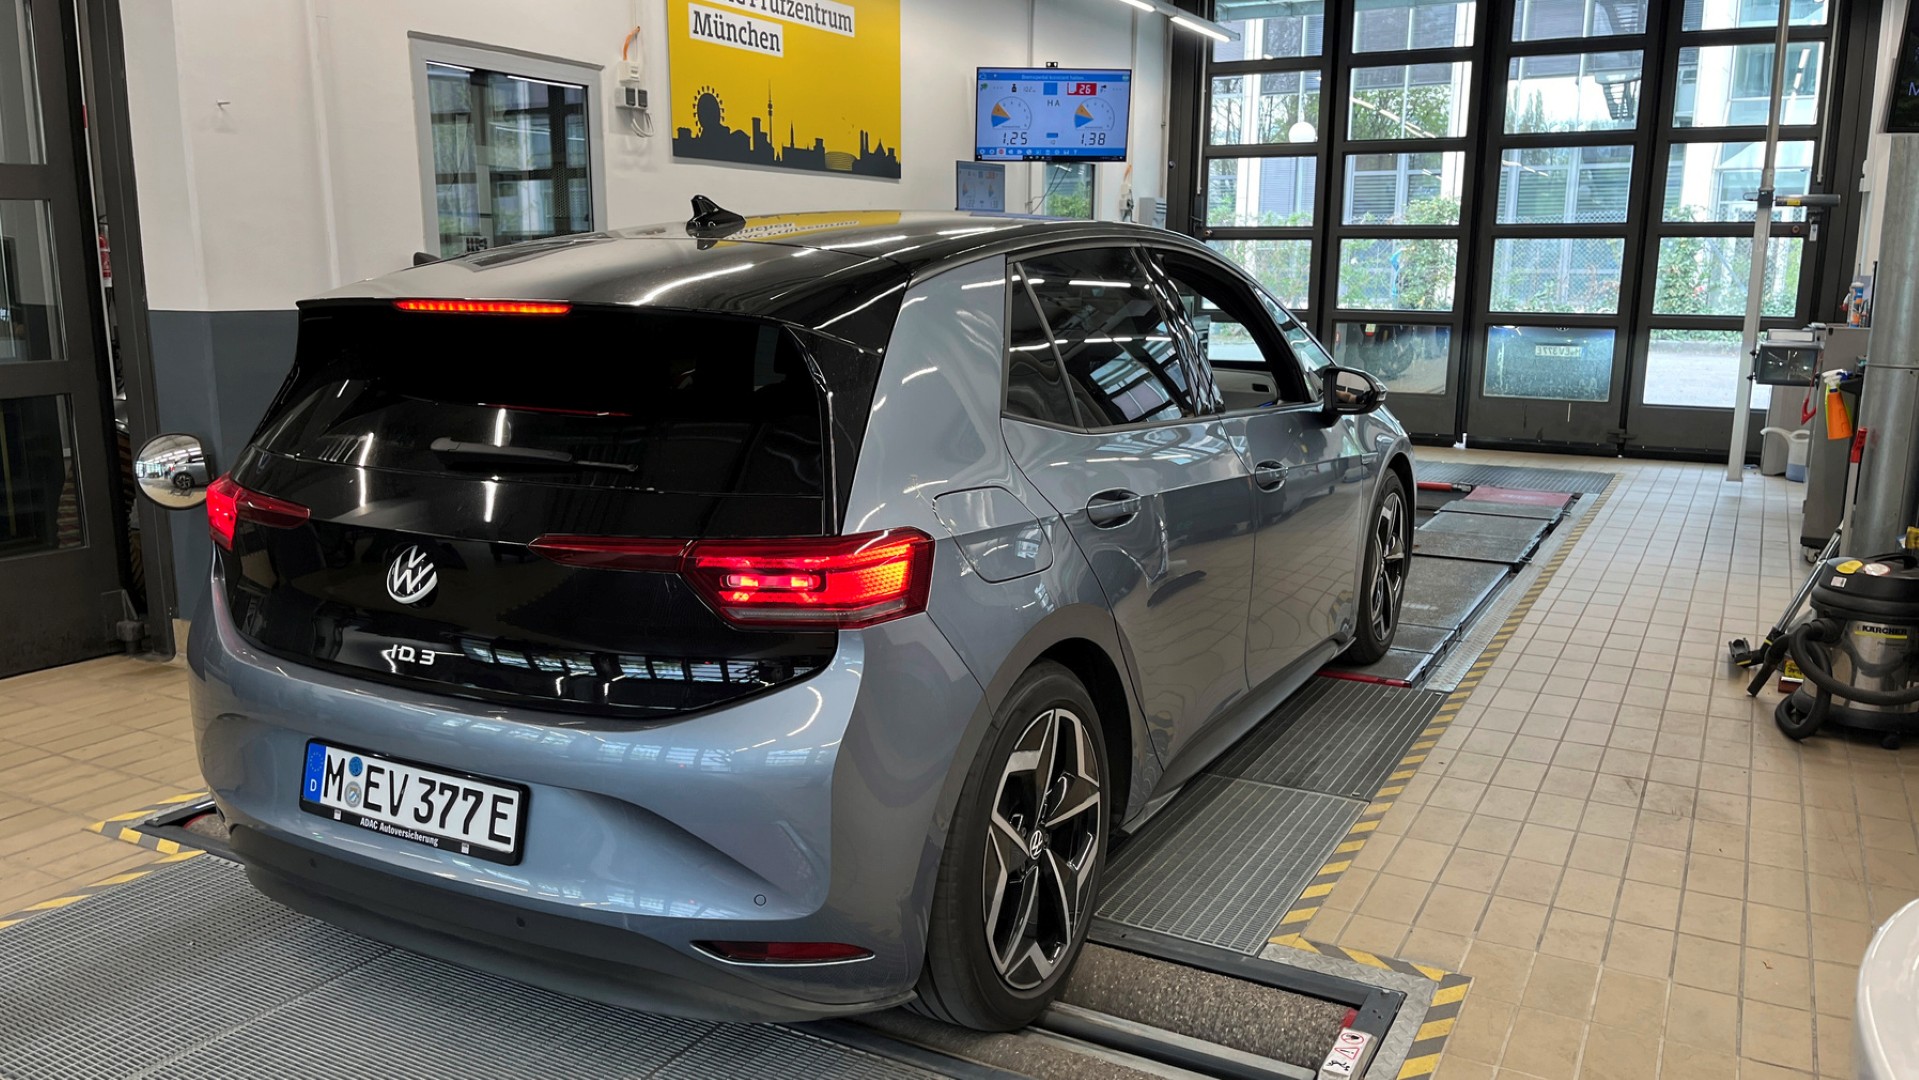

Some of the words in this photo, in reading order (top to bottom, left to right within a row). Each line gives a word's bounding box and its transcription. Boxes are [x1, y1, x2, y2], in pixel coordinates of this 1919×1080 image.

[693, 11, 780, 52] München
[1079, 84, 1091, 95] 26
[309, 778, 317, 792] D
[323, 754, 346, 802] M
[360, 817, 379, 830] ADAC
[379, 821, 439, 847] Autoversicherung
